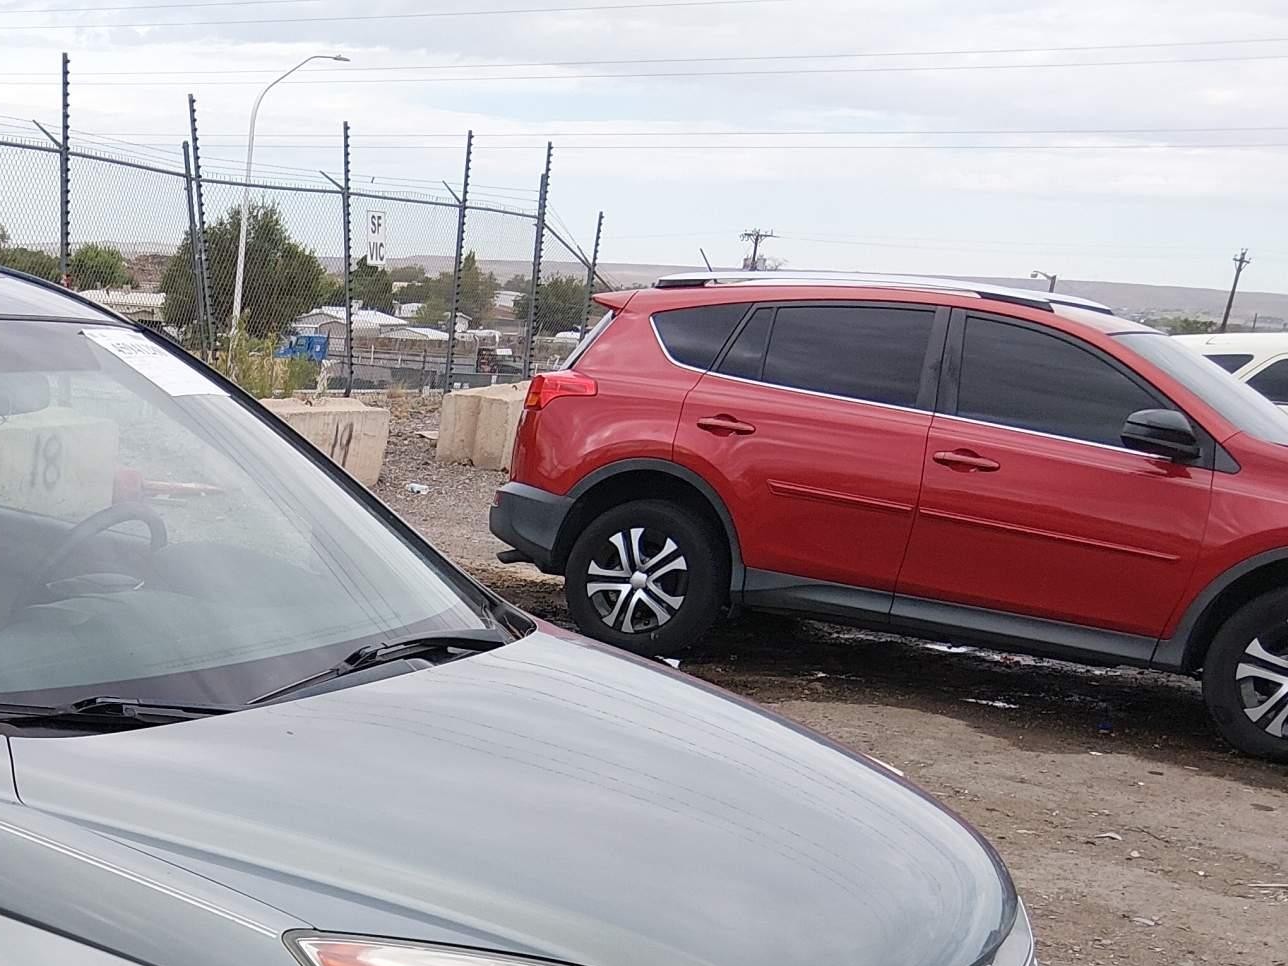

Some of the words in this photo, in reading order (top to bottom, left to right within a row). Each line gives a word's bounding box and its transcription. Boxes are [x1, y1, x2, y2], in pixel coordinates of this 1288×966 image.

[370, 213, 382, 235] SF
[368, 241, 385, 262] VIC
[29, 432, 61, 490] 18
